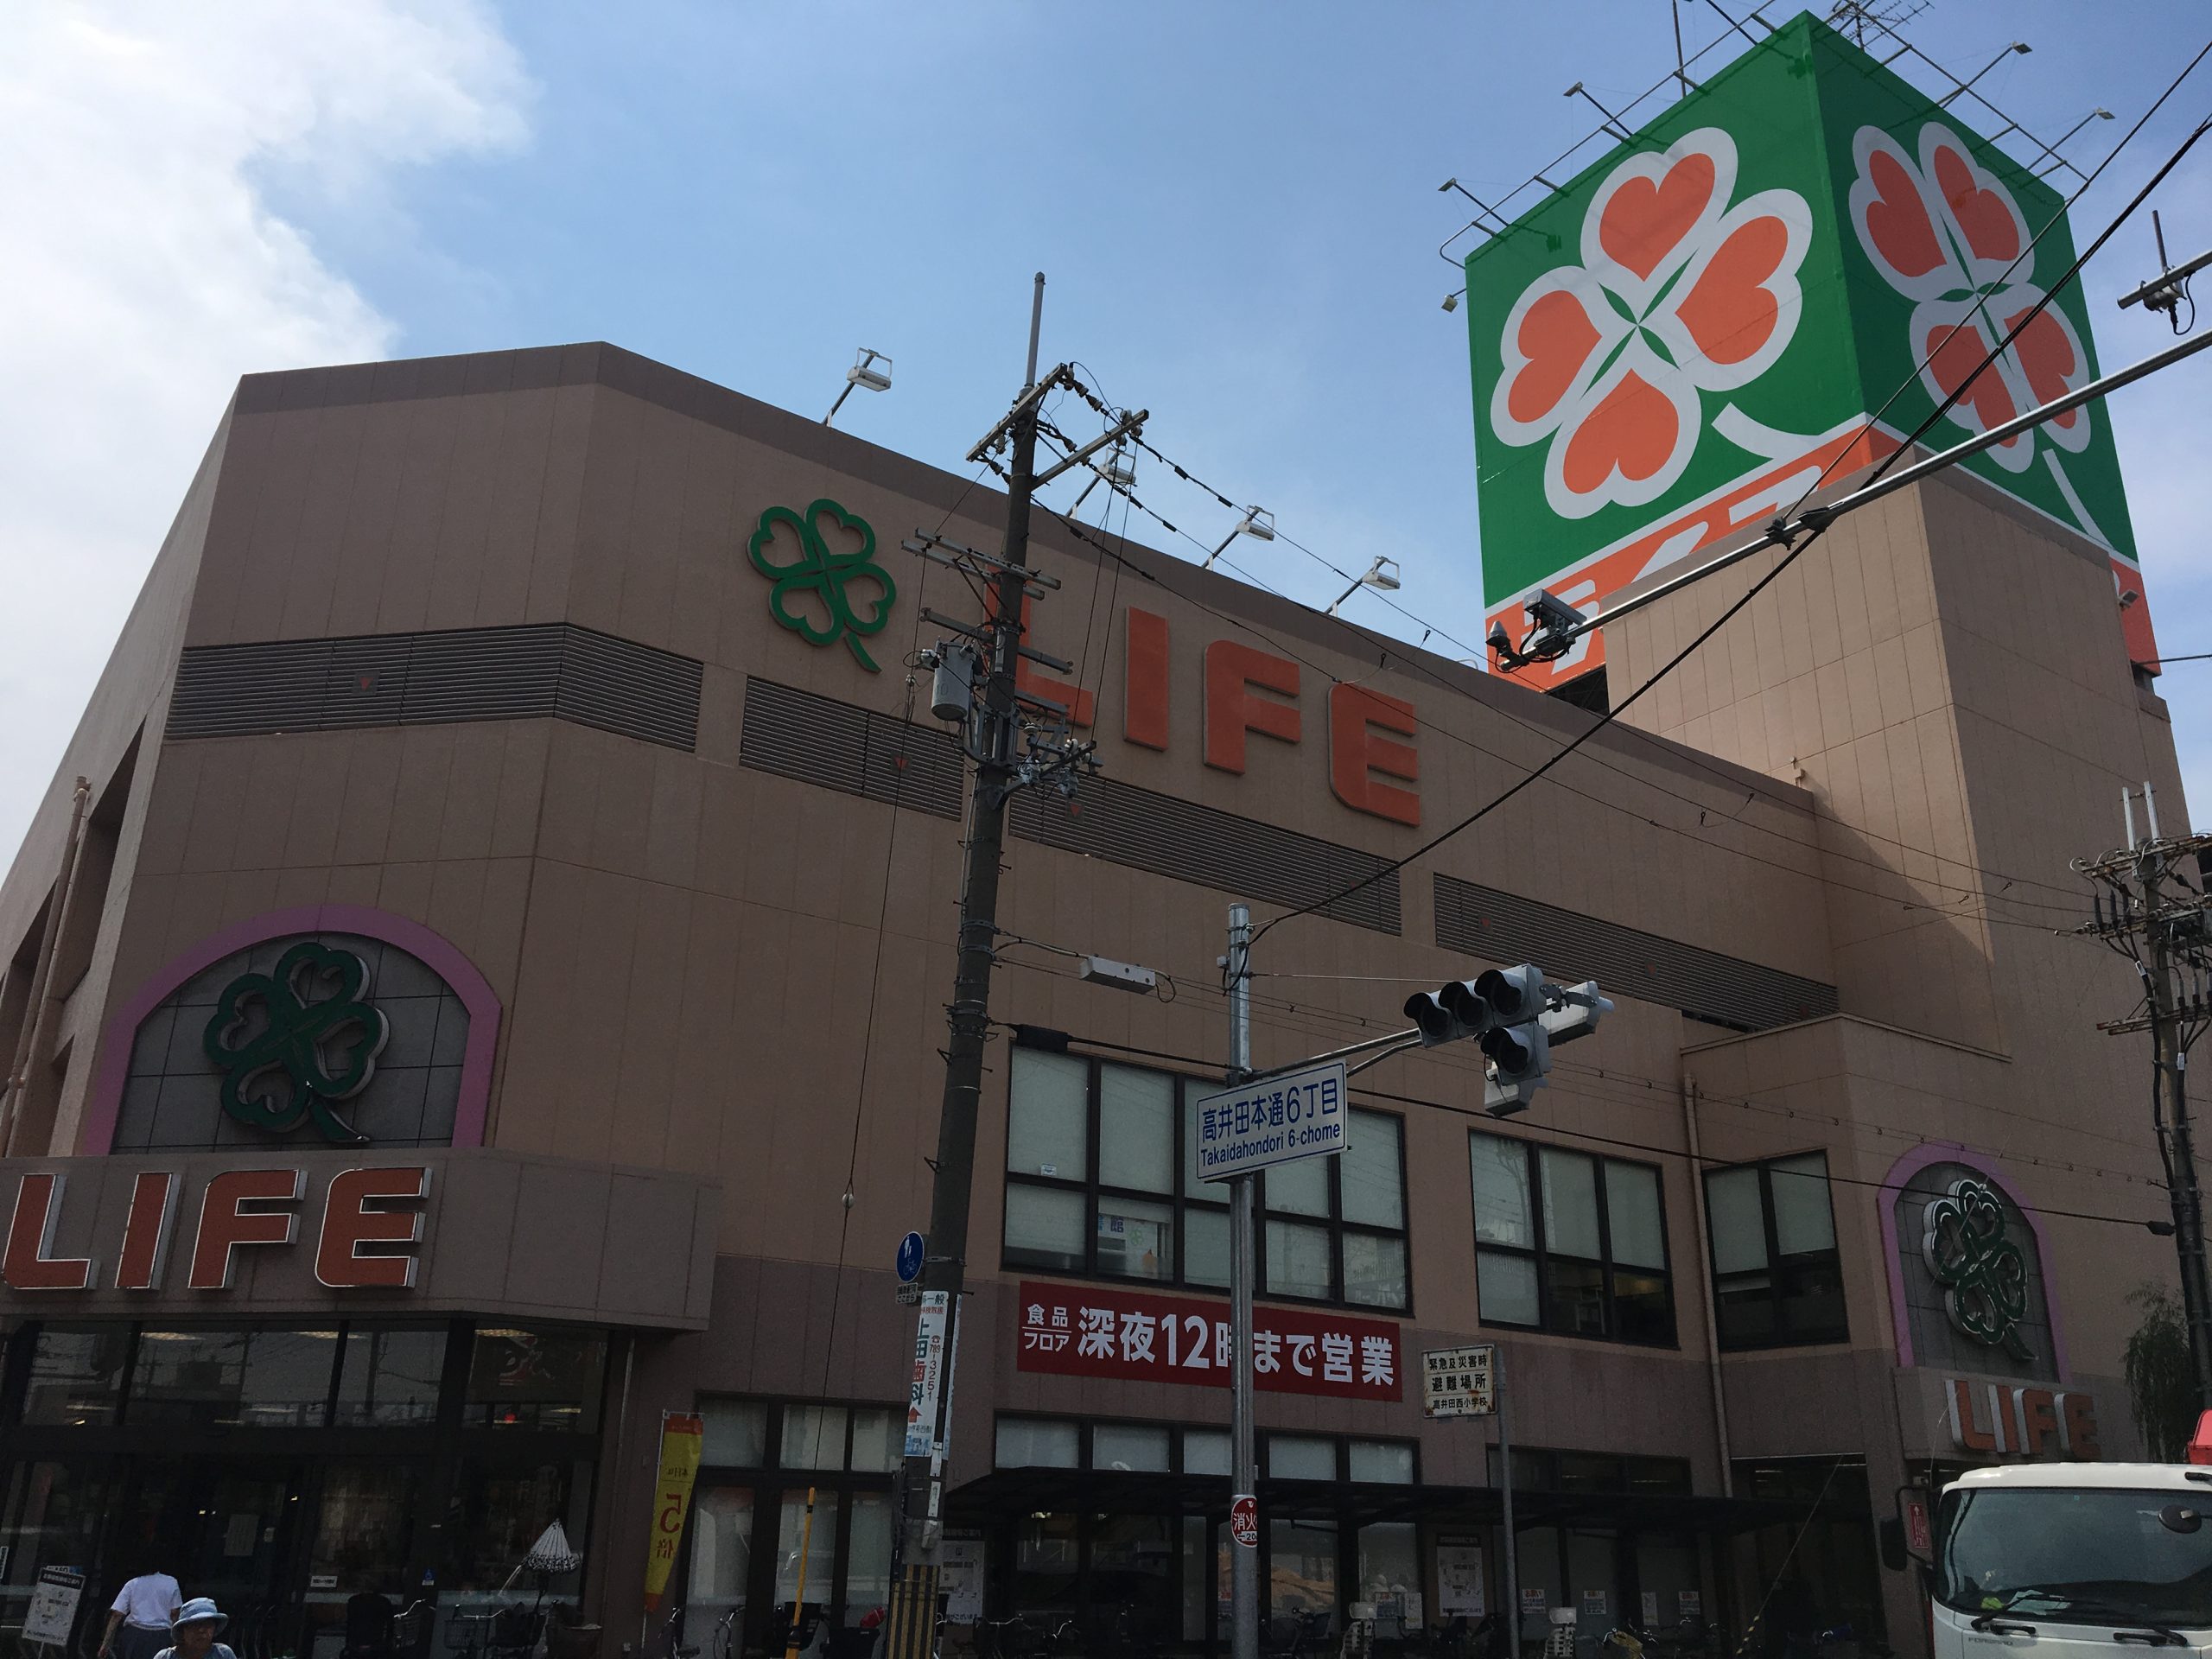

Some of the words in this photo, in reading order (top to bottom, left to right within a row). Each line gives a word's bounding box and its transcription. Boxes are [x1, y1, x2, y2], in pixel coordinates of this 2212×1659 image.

[982, 566, 1422, 828] LIFE
[1202, 1077, 1338, 1143] 高井田本通6丁目
[1200, 1131, 1284, 1167] Takaidahondori
[1287, 1122, 1341, 1148] 6-chome
[3, 1166, 434, 1291] LIFE
[1027, 1303, 1070, 1329] 食品
[1024, 1332, 1071, 1352] フロア
[1428, 1353, 1488, 1371] 緊急及災害時
[1431, 1372, 1487, 1392] 避難場所
[1432, 1396, 1488, 1410] 高井田西小学校
[1945, 1378, 2101, 1459] LIFE
[1233, 1512, 1257, 1530] 消火
